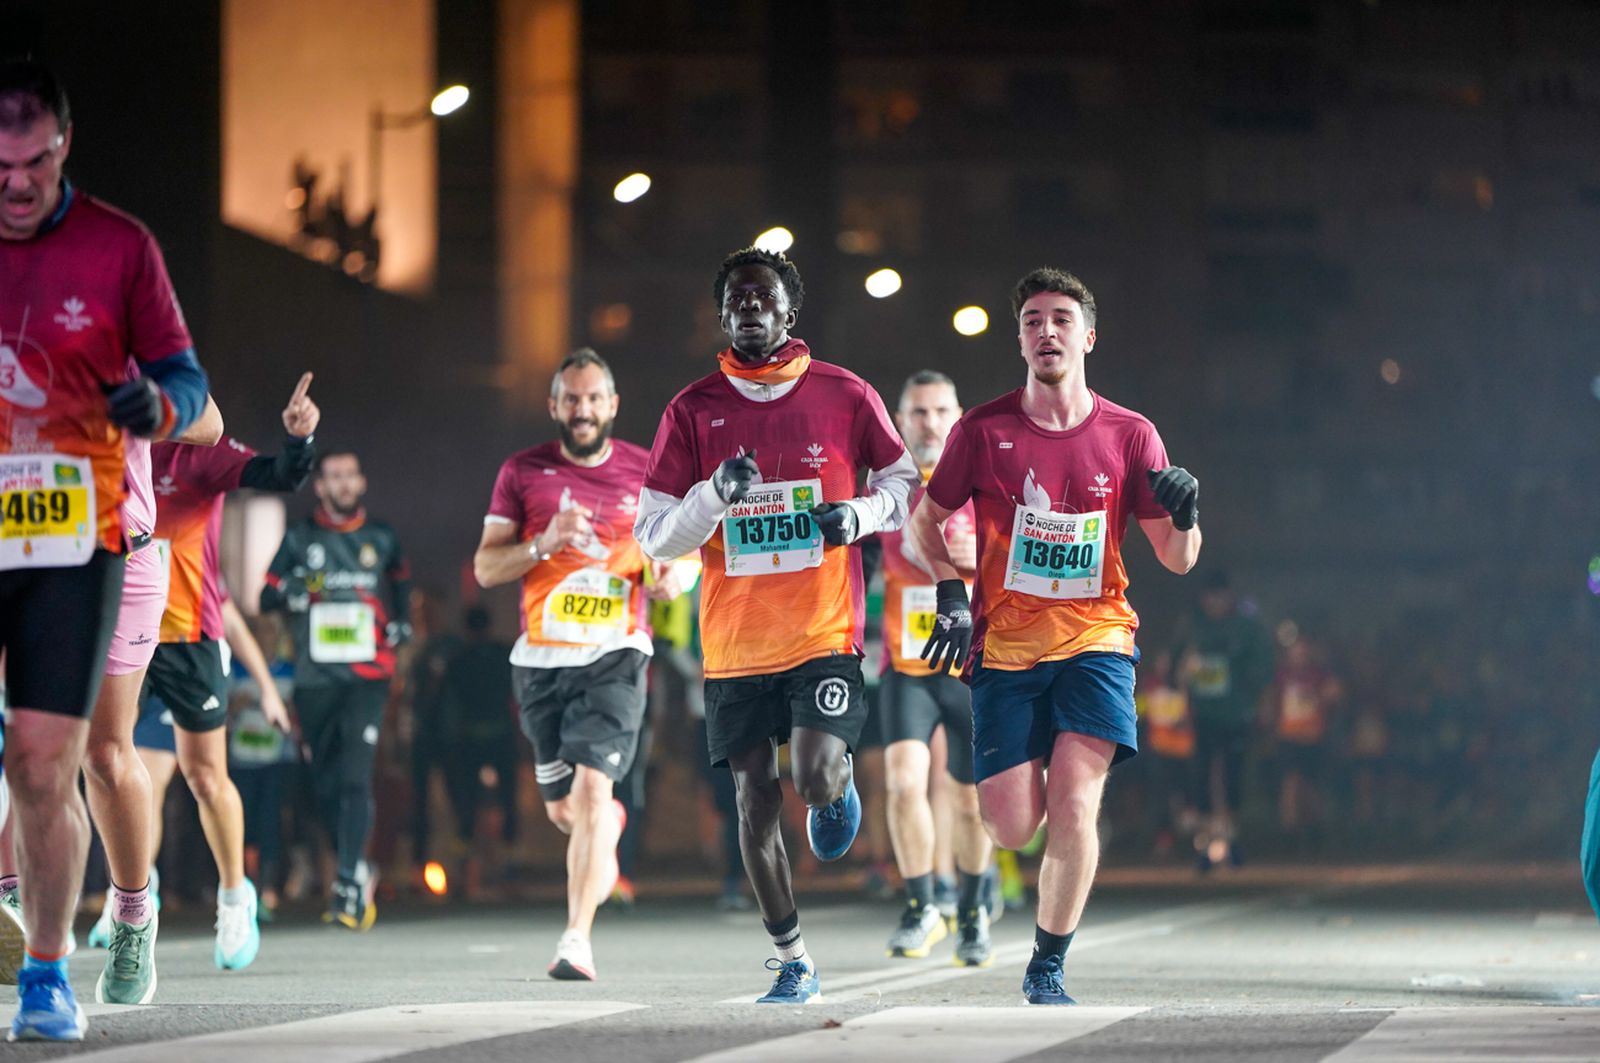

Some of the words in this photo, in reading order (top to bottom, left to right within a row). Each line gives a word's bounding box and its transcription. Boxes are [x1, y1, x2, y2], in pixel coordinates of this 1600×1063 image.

[741, 494, 771, 504] NOCHE
[772, 492, 784, 502] DE
[0, 491, 69, 525] 469
[732, 507, 751, 517] SAN
[753, 501, 785, 516] ANTÓN
[736, 513, 811, 544] 13750
[1023, 527, 1042, 539] SAN
[1035, 521, 1064, 532] NOCHE
[1065, 523, 1076, 532] DE
[1023, 540, 1093, 570] 13640
[1048, 571, 1066, 579] Diego
[563, 594, 612, 618] 8279
